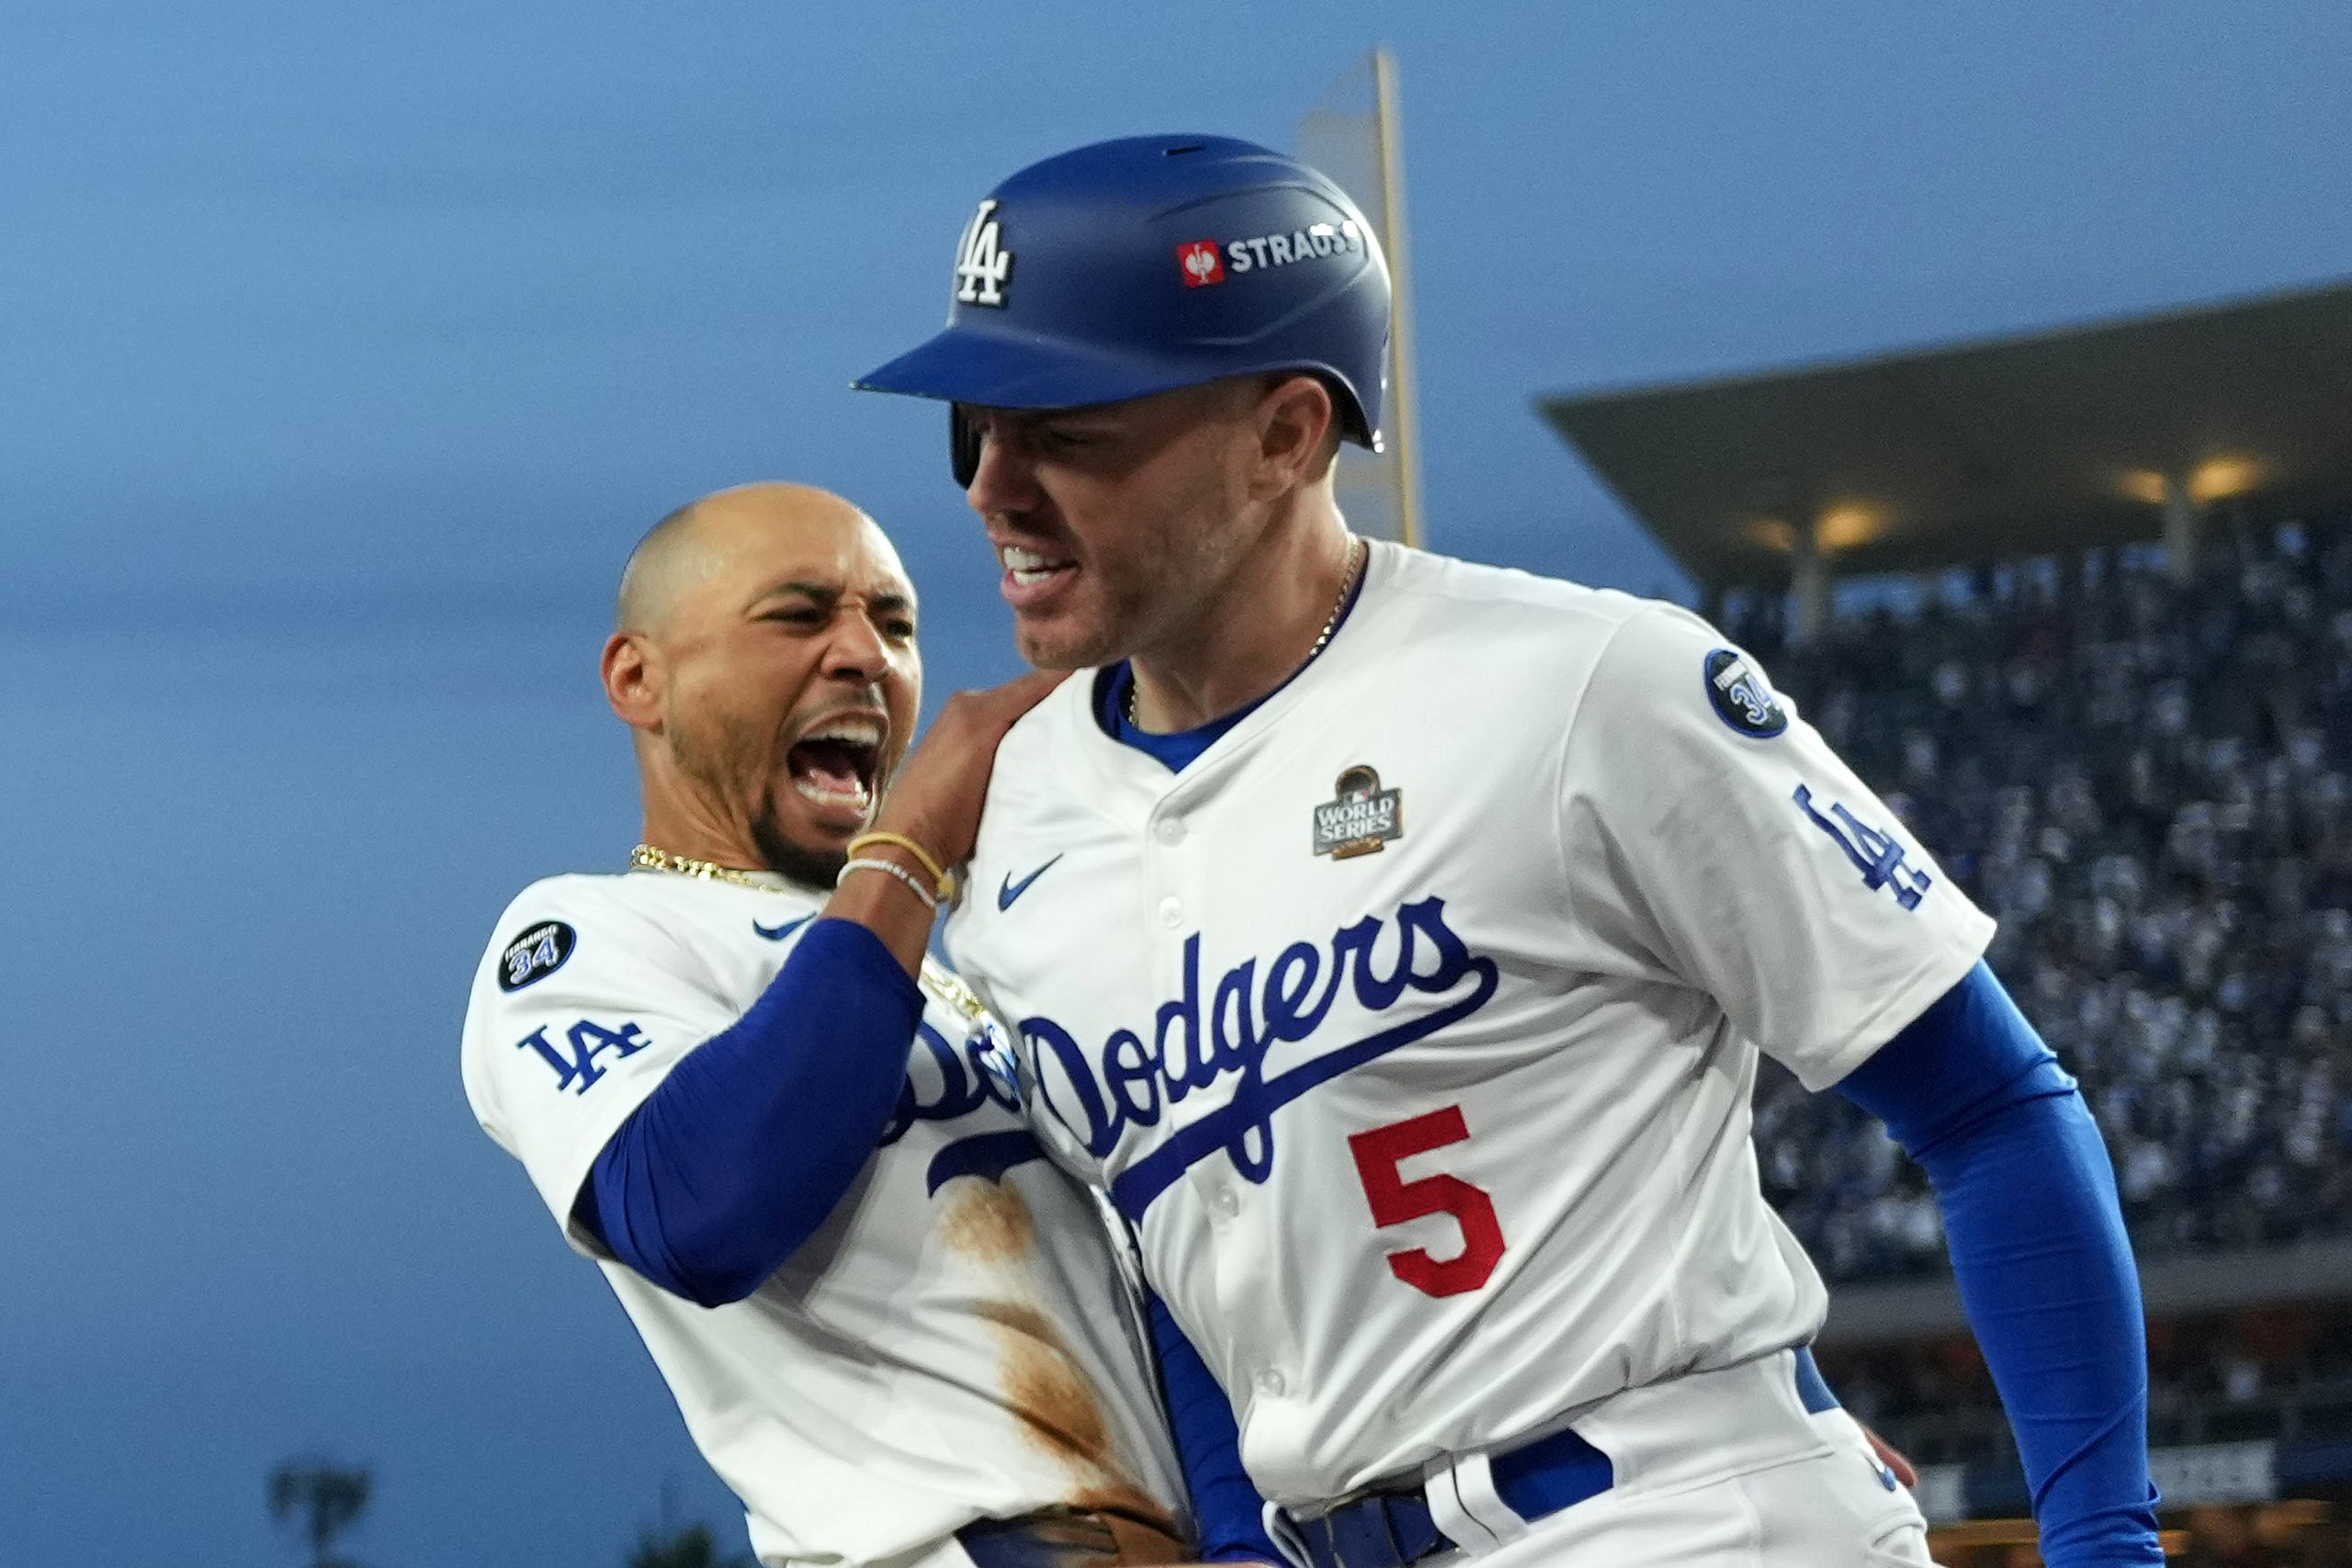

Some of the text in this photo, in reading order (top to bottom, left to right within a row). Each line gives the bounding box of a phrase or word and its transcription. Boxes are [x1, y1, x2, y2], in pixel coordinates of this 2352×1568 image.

[957, 199, 1010, 304] LA
[1227, 221, 1360, 273] STRAUSS
[1317, 797, 1395, 827] WORLD
[1319, 814, 1392, 842] SERIES
[1792, 784, 1932, 911] LA
[508, 935, 560, 985] 34
[516, 1019, 652, 1096] LA
[1018, 896, 1499, 1222] Dodgers
[1348, 1105, 1507, 1299] 5
